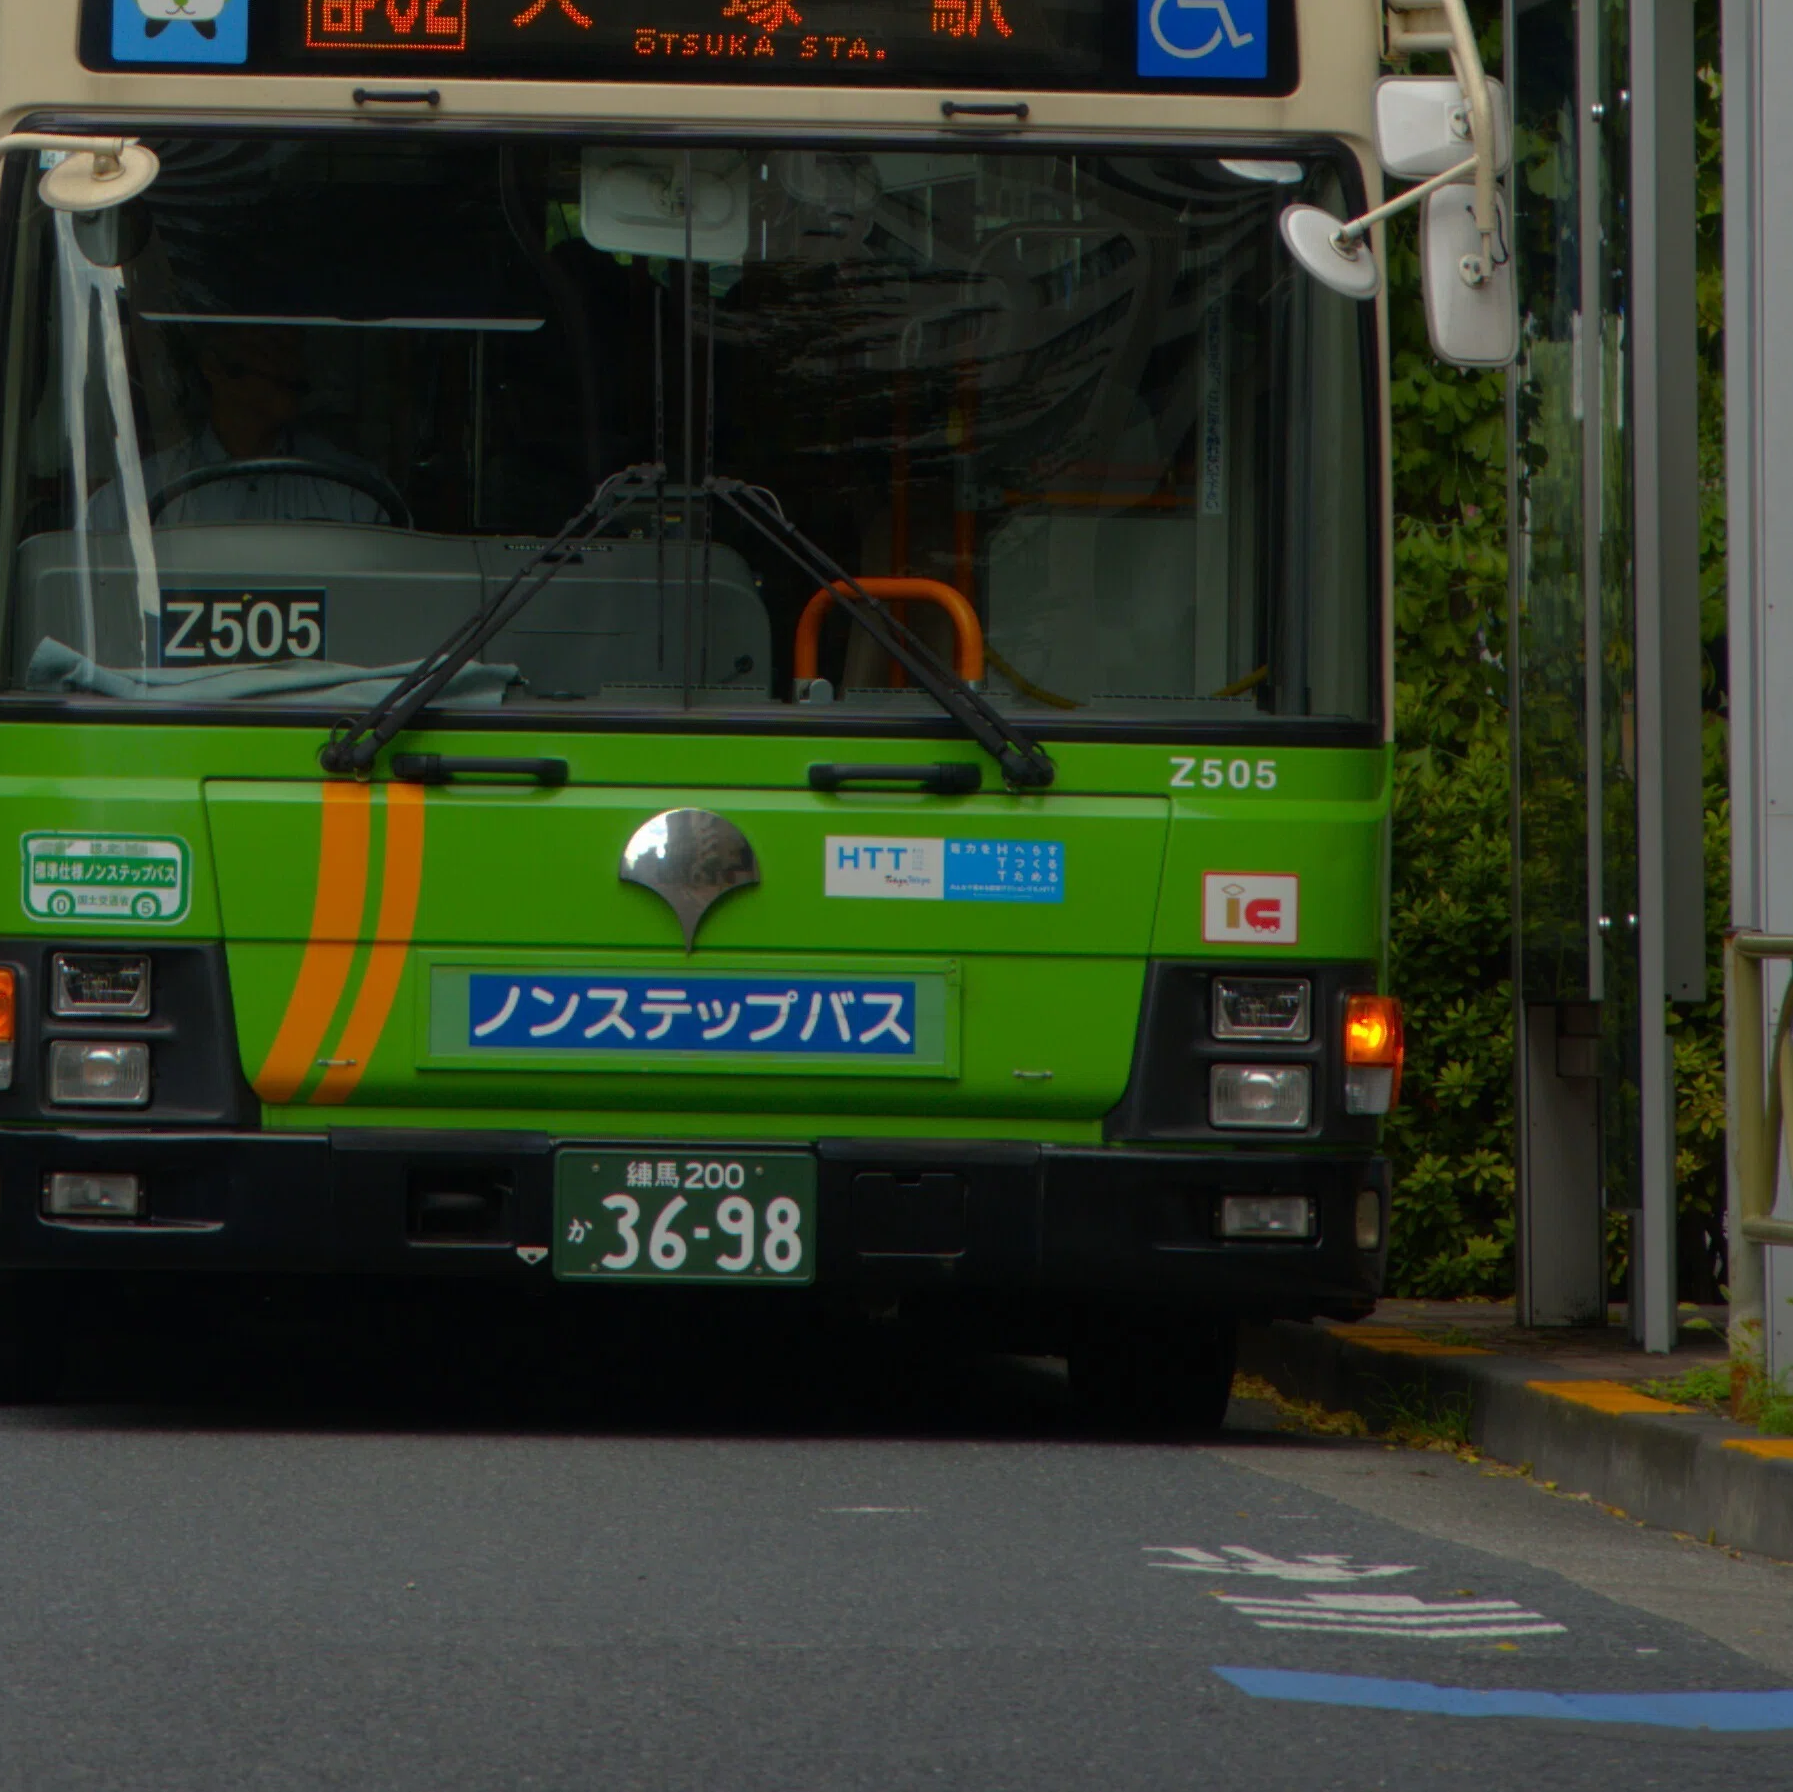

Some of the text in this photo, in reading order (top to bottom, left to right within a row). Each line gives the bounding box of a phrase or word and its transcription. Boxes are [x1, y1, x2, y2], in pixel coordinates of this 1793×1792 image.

[801, 36, 888, 60] STA.
[164, 600, 321, 658] Z505
[1169, 756, 1277, 789] Z505
[837, 846, 908, 871] HTT
[474, 985, 911, 1045] ノンステップバス
[567, 1193, 803, 1274] か 36-98
